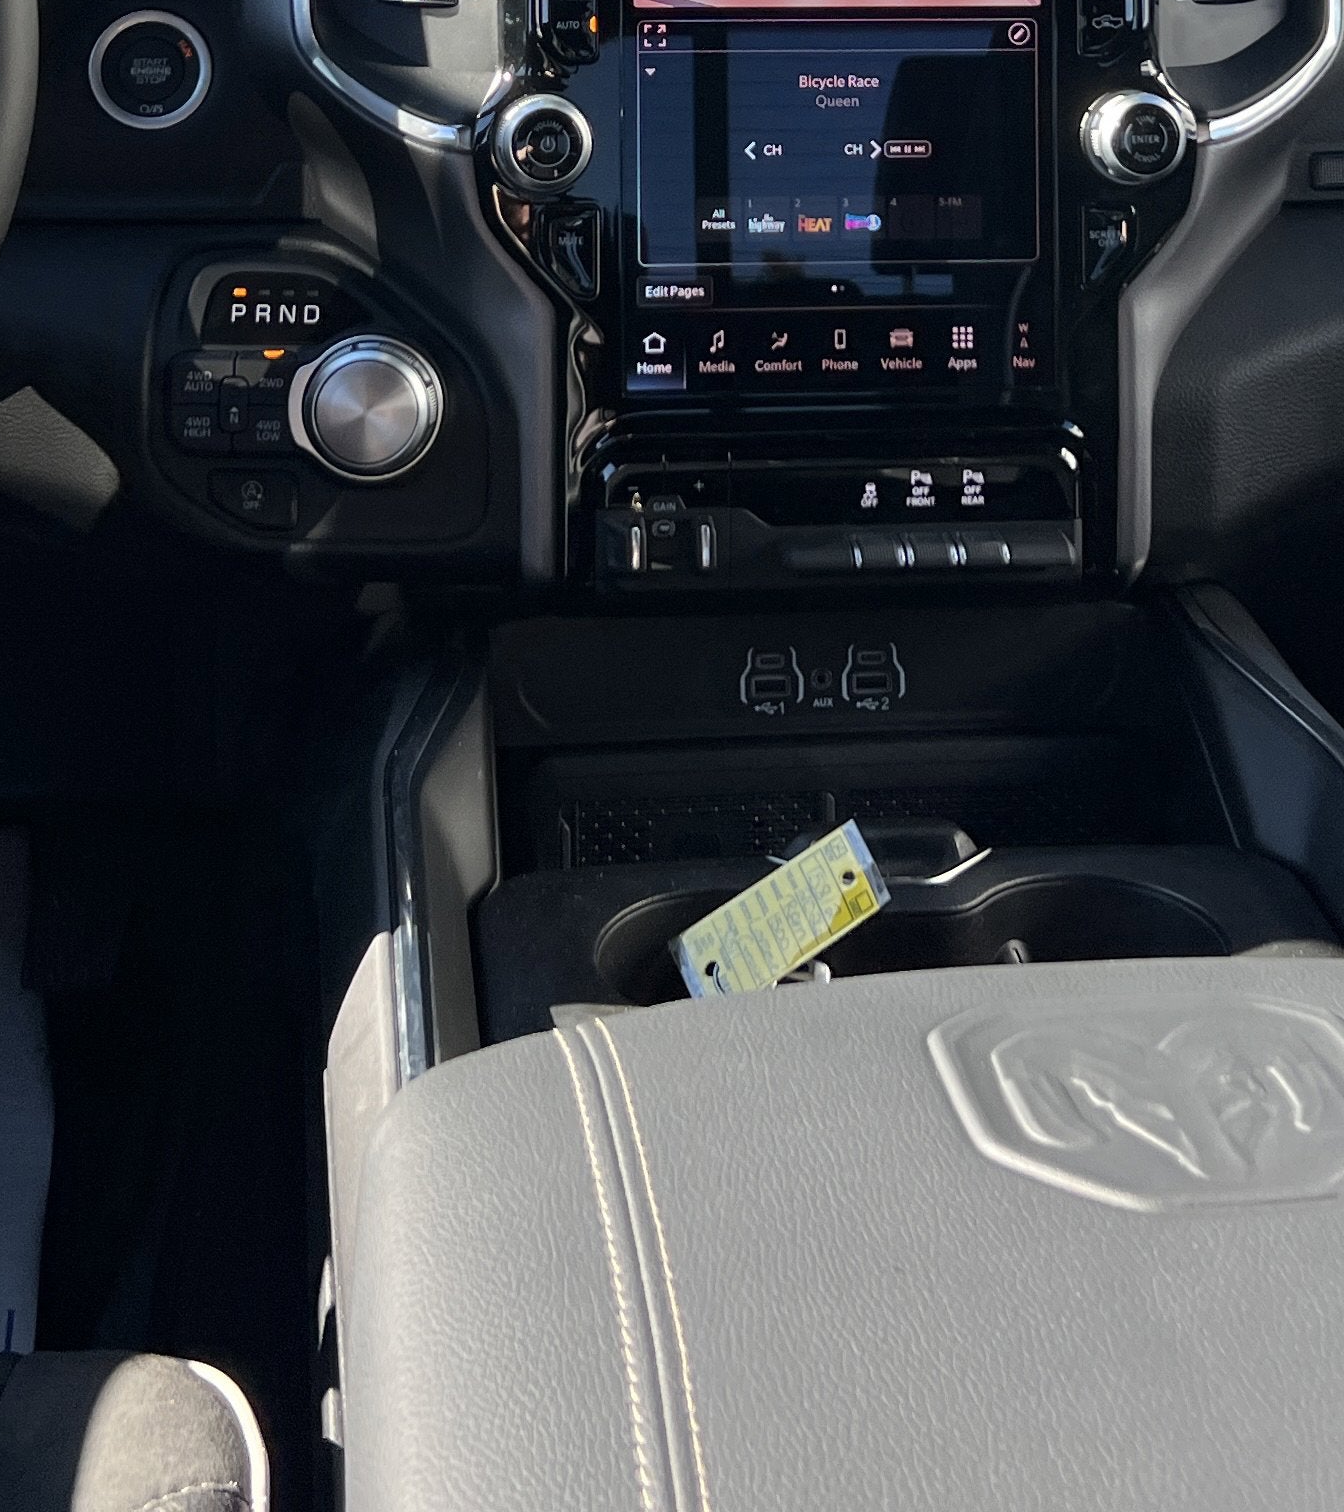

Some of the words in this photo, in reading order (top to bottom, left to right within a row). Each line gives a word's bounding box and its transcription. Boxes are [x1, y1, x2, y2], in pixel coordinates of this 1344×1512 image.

[556, 21, 580, 30] AUTO
[799, 74, 845, 90] Bicycle
[847, 74, 880, 88] Race
[815, 94, 860, 109] Queen
[534, 119, 564, 133] VOLUME
[1131, 135, 1160, 145] ENTER
[763, 144, 782, 156] CH
[844, 144, 863, 156] CH
[712, 208, 726, 219] All
[702, 220, 736, 230] Presets
[797, 214, 833, 233] HEAT
[645, 286, 669, 298] Edit
[670, 285, 705, 299] Pages
[231, 304, 247, 323] P
[255, 304, 271, 323] R
[279, 304, 297, 323] N
[303, 304, 320, 324] D
[699, 360, 736, 373] Media
[755, 359, 802, 372] Comfort
[822, 358, 859, 371] Phone
[880, 357, 923, 370] Vehicle
[948, 356, 978, 371] Apps
[1012, 355, 1036, 368] Nav
[637, 362, 672, 375] Home
[186, 370, 213, 382] 4WD
[184, 380, 214, 392] AUTO
[259, 377, 284, 389] 2WD
[185, 416, 211, 427] 4WD
[229, 413, 239, 425] N
[255, 419, 281, 431] 4WD
[183, 426, 211, 438] HIGH
[256, 430, 281, 442] LOW
[912, 486, 930, 496] OFF
[964, 485, 982, 494] OFF
[906, 496, 936, 507] FRONT
[961, 495, 985, 506] REAR
[653, 502, 676, 512] GAIN
[779, 701, 785, 715] 1
[812, 697, 834, 708] AUX
[881, 697, 889, 711] 2
